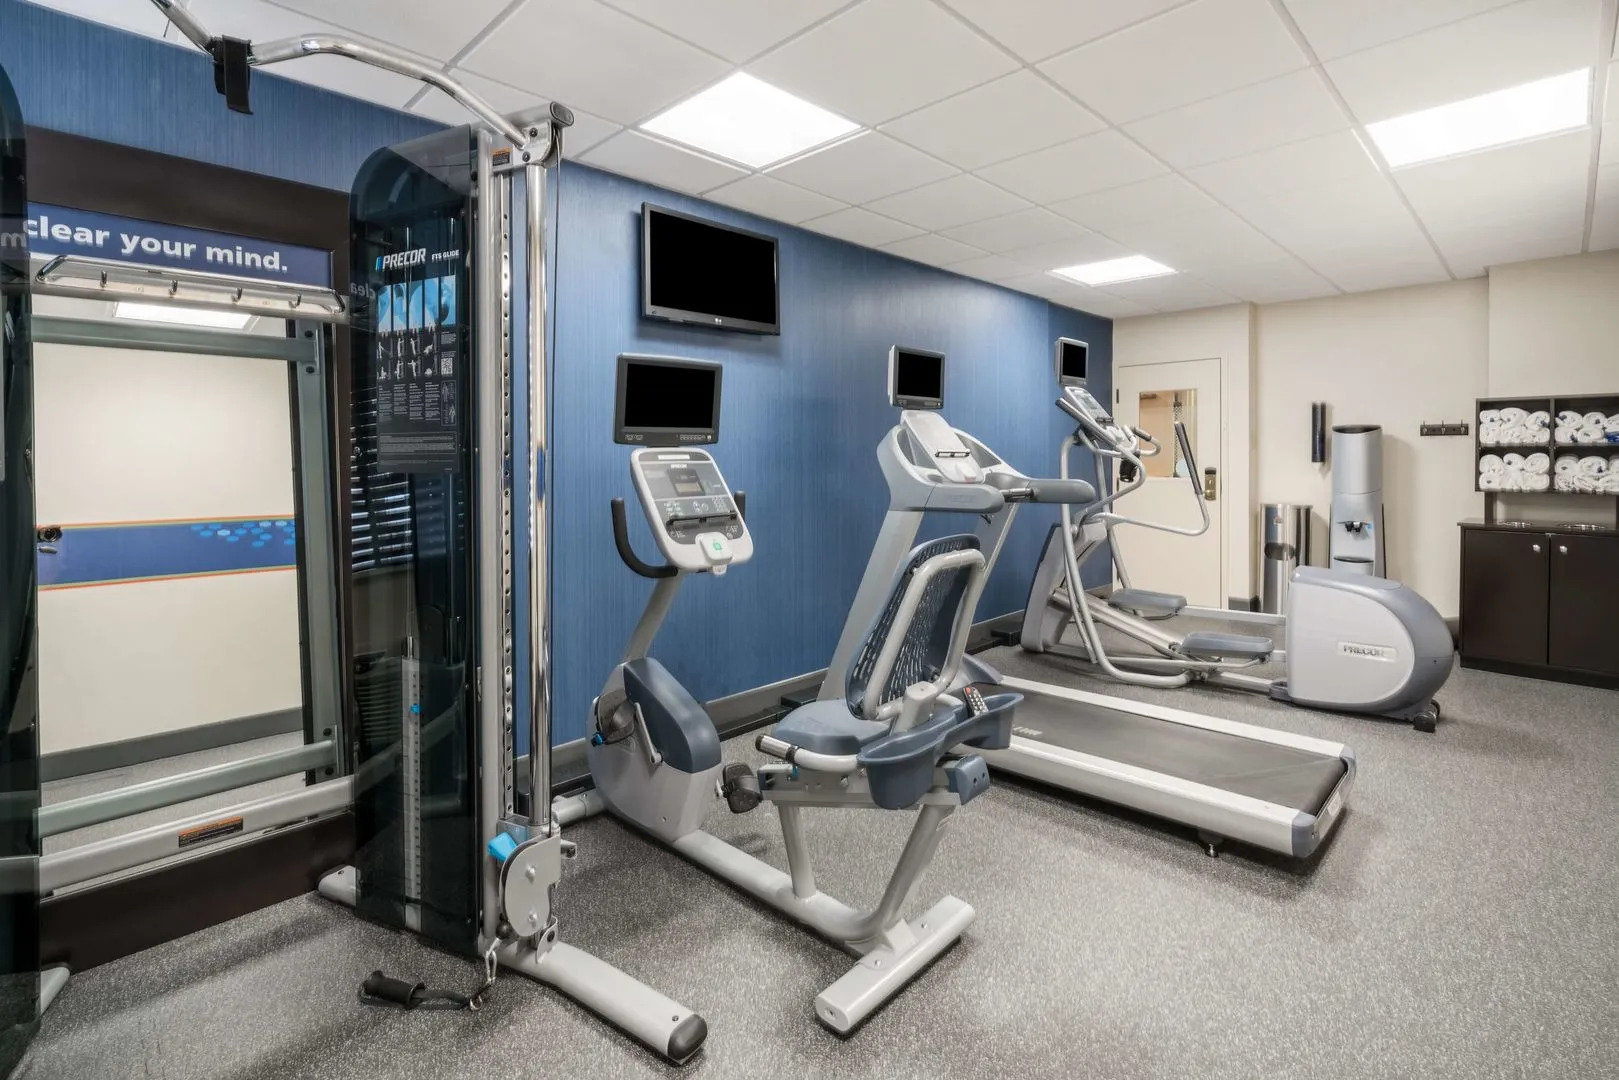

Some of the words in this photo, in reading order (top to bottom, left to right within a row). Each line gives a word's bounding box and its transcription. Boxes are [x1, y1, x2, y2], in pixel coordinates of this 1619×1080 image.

[23, 215, 110, 247] clear
[120, 232, 196, 259] your
[206, 246, 288, 272] mind.
[382, 248, 426, 270] PRECOR
[442, 250, 459, 258] GLIDE
